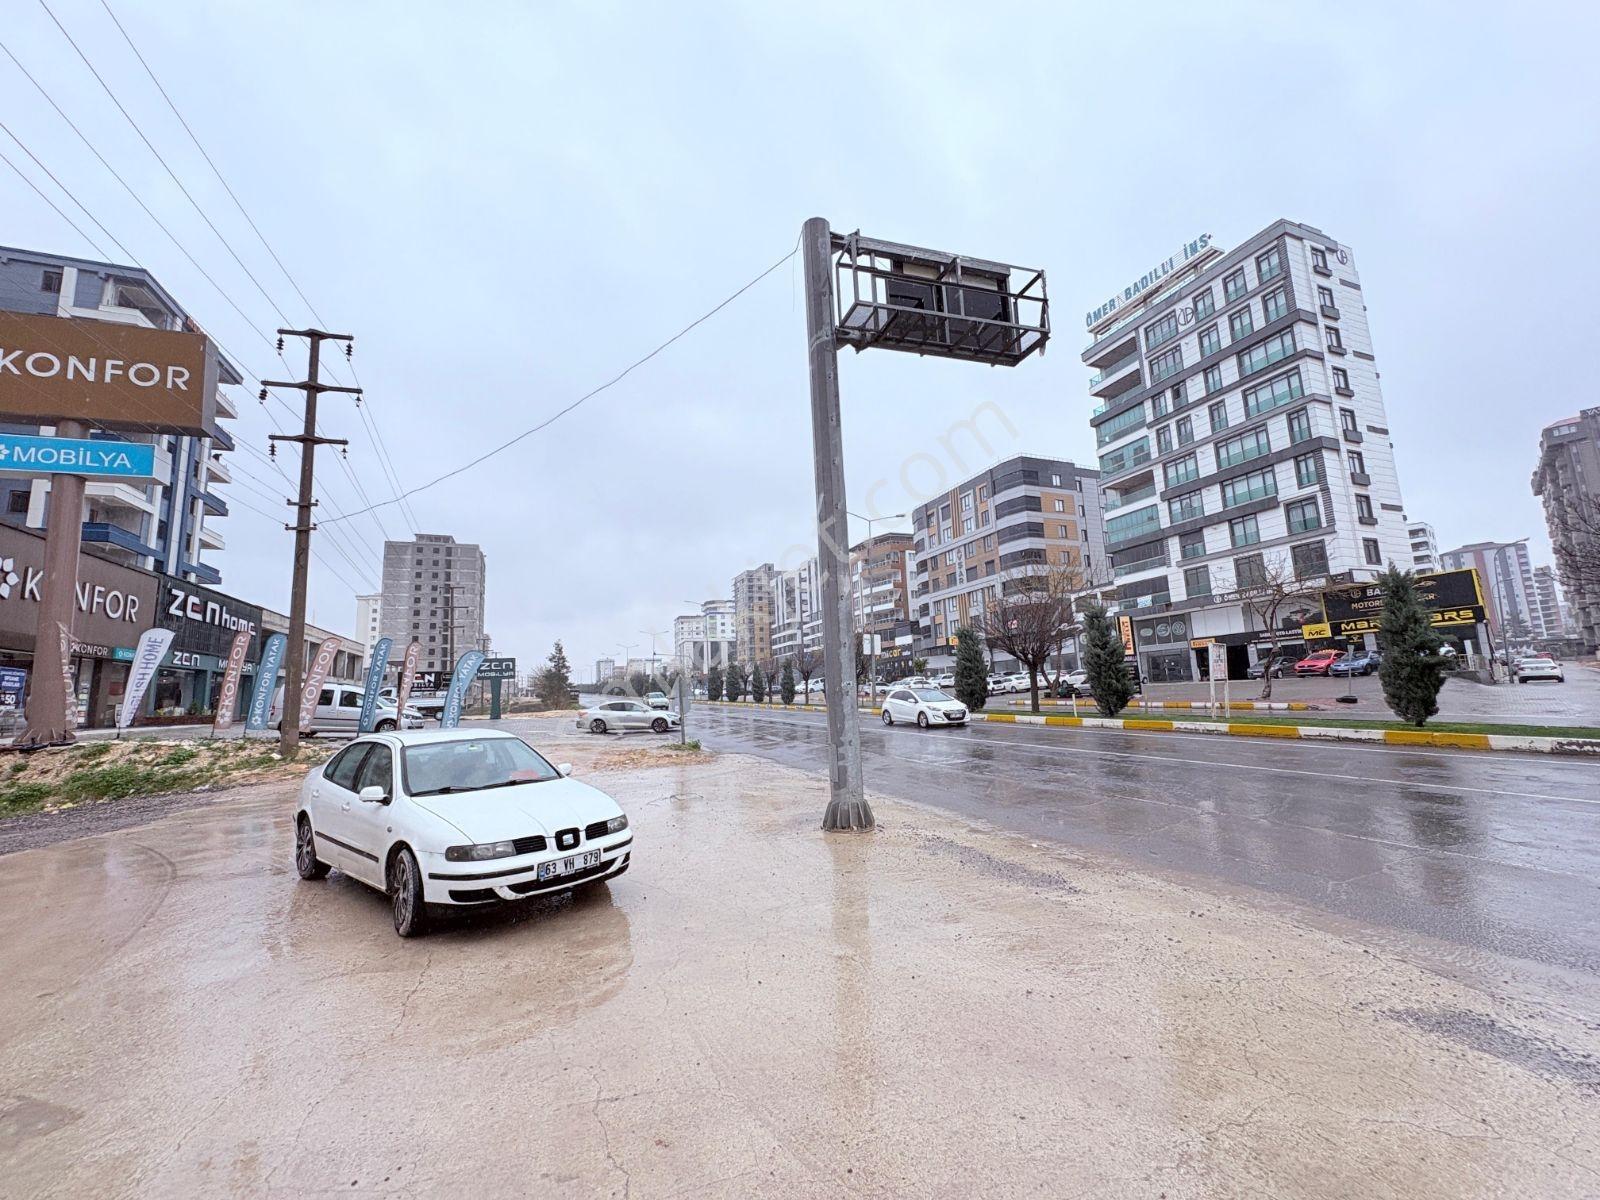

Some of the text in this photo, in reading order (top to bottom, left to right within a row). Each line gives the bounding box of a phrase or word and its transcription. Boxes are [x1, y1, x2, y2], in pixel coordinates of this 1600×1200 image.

[0, 348, 191, 391] KONFOR
[13, 446, 132, 469] MOBİLYA
[24, 566, 140, 624] KNFOR
[74, 642, 109, 657] KONFOR
[139, 637, 164, 669] HOME
[222, 635, 246, 706] KONFOR
[375, 643, 388, 671] YATAK
[254, 638, 281, 714] KONFOR YATAK
[302, 641, 336, 709] KONFOR
[449, 654, 478, 720] KONFO YATAK
[545, 863, 557, 875] 63
[563, 857, 575, 870] VH
[583, 852, 599, 866] 879
